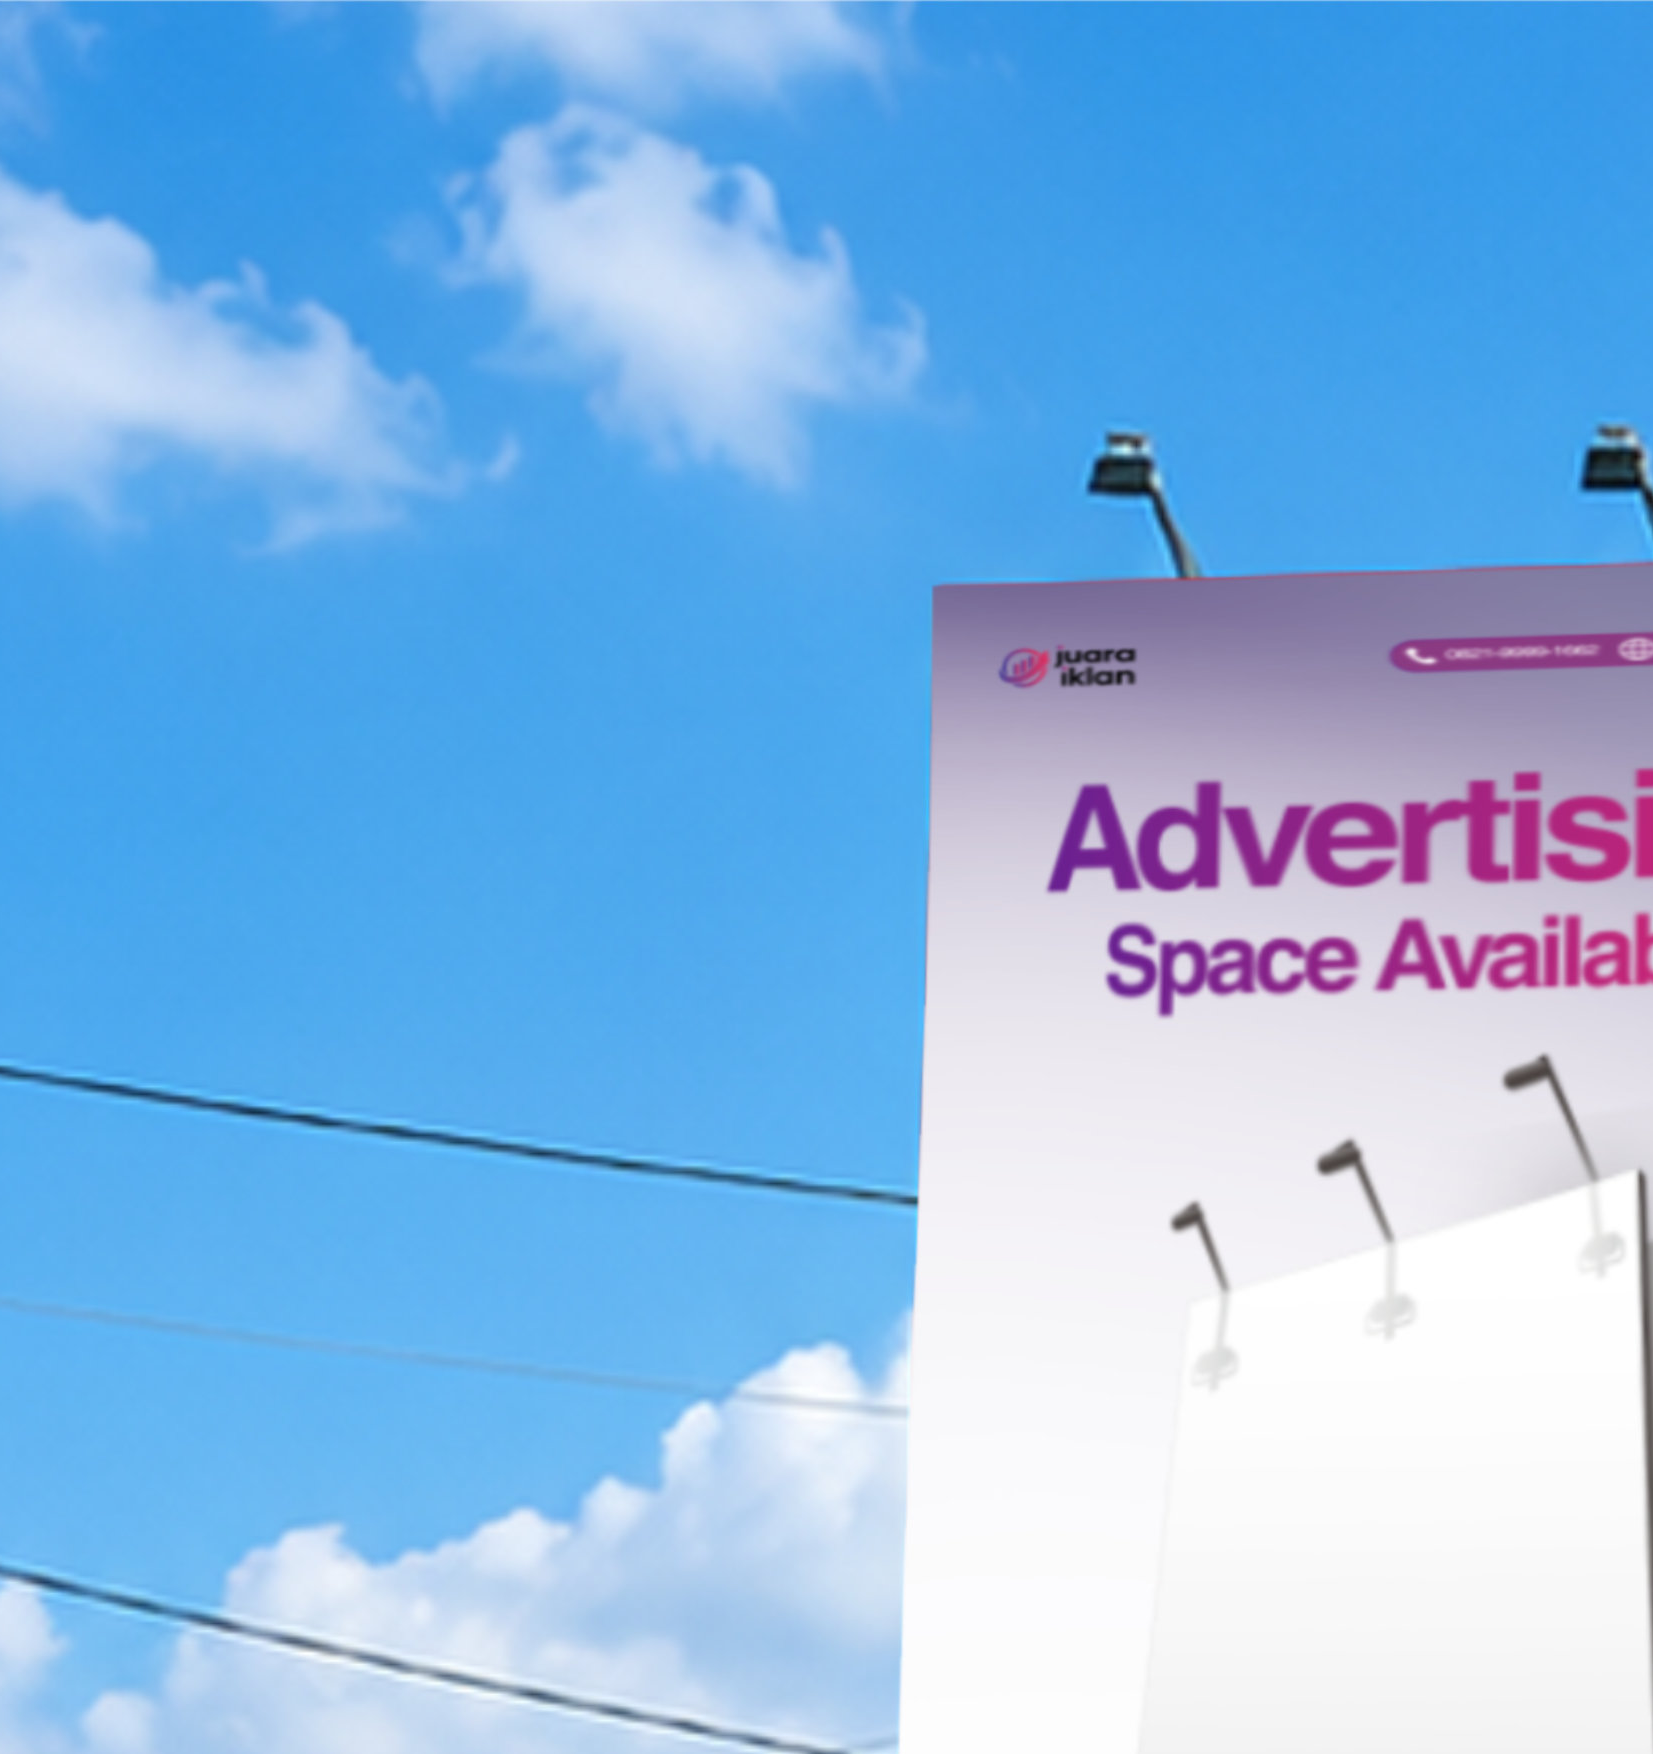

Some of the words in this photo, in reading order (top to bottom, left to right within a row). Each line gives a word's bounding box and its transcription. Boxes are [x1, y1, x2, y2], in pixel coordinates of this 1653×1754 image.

[1055, 644, 1136, 668] juara
[1060, 666, 1136, 687] iklan
[1105, 922, 1360, 1017] Space
